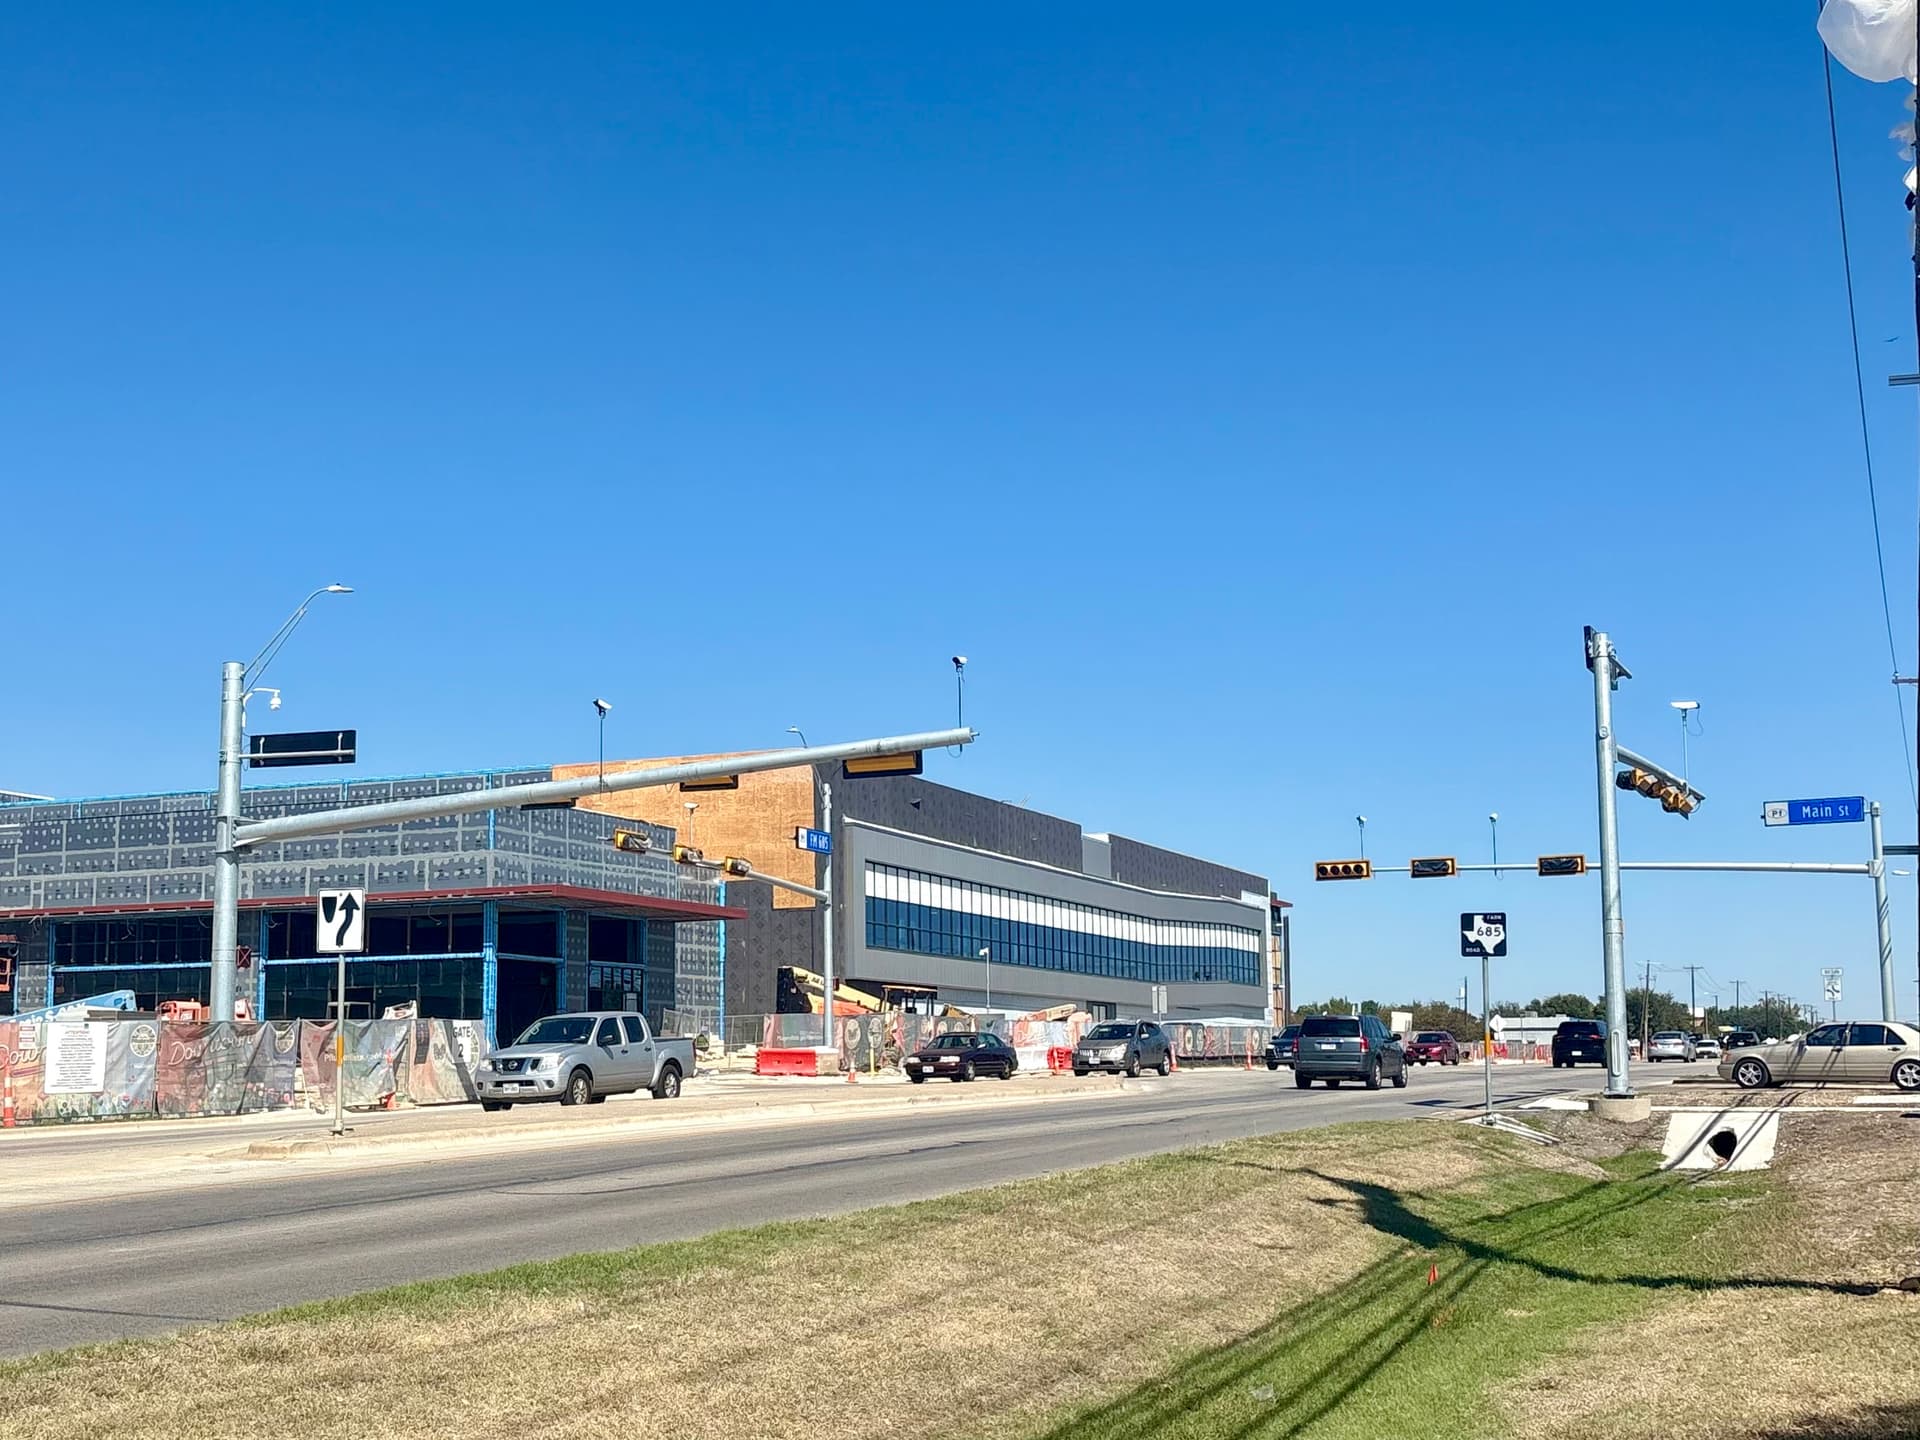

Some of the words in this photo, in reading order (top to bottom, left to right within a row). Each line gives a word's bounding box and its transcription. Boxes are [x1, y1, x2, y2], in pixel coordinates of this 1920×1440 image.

[1802, 803, 1832, 818] Main
[1839, 804, 1849, 817] St
[1476, 926, 1502, 937] 685
[452, 1026, 471, 1038] GATE
[457, 1043, 464, 1058] 2
